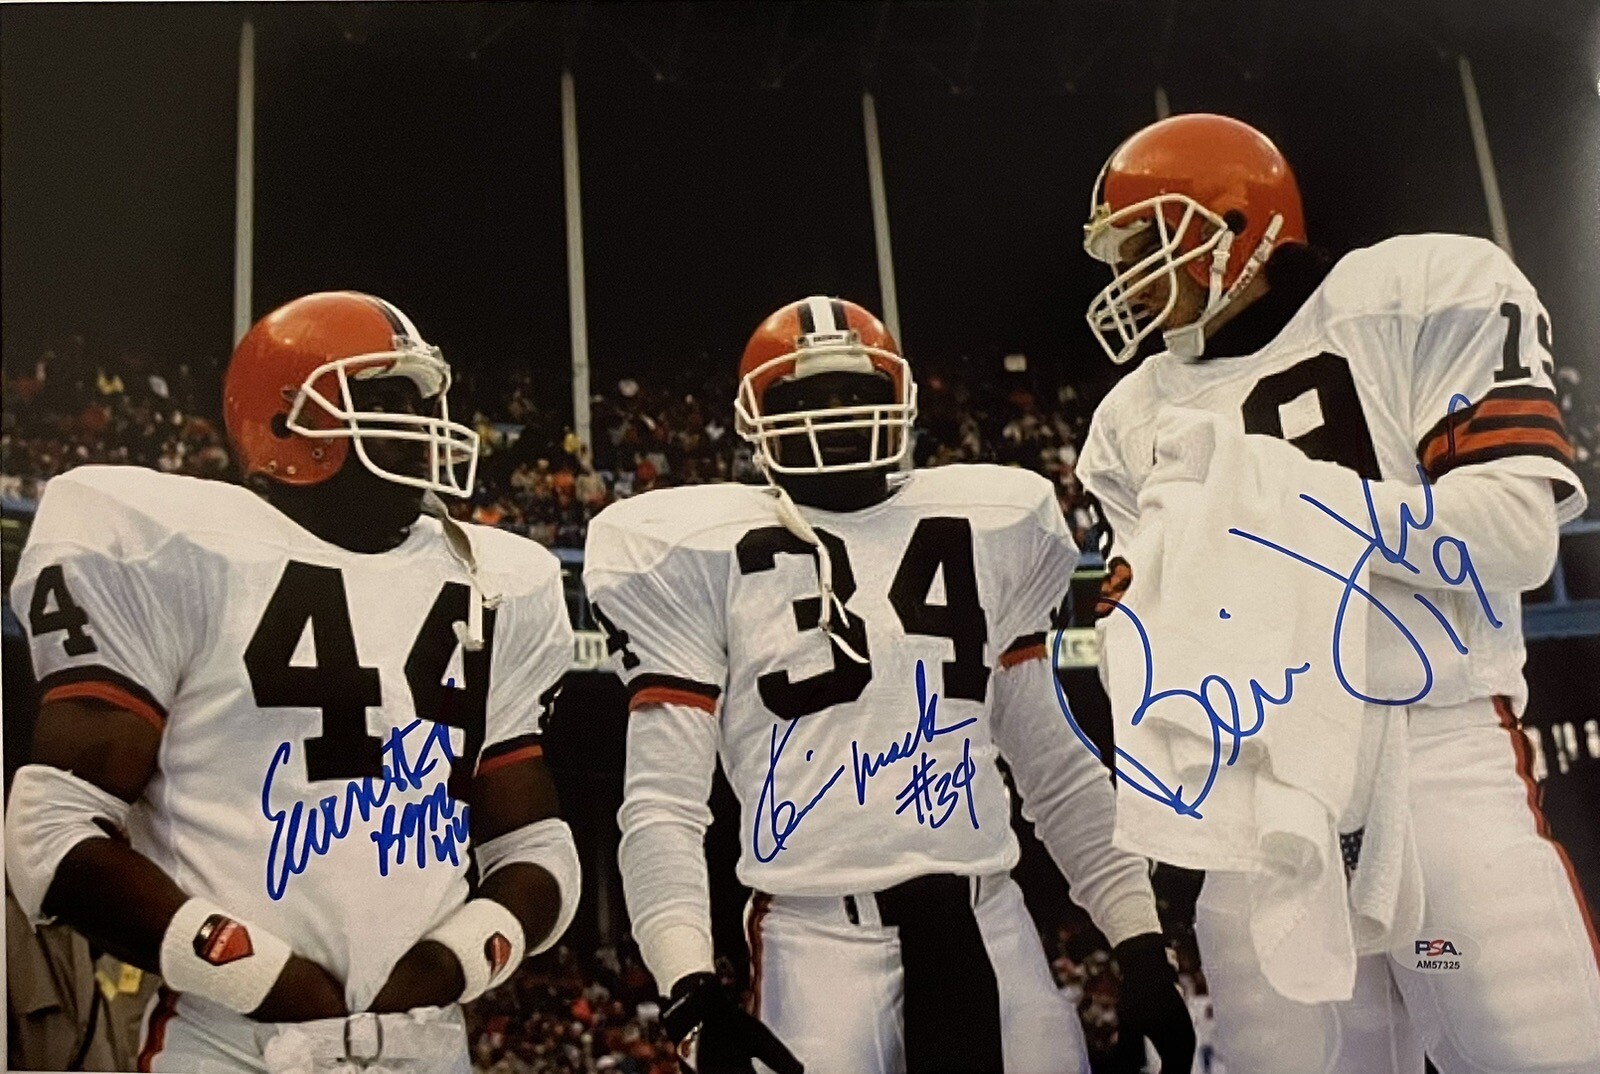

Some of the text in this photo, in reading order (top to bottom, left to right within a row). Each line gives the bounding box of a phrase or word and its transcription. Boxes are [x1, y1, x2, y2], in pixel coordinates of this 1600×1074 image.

[28, 564, 98, 656] 4
[243, 559, 497, 784] 44
[736, 516, 990, 720] 34
[1416, 960, 1460, 970] AM57325
